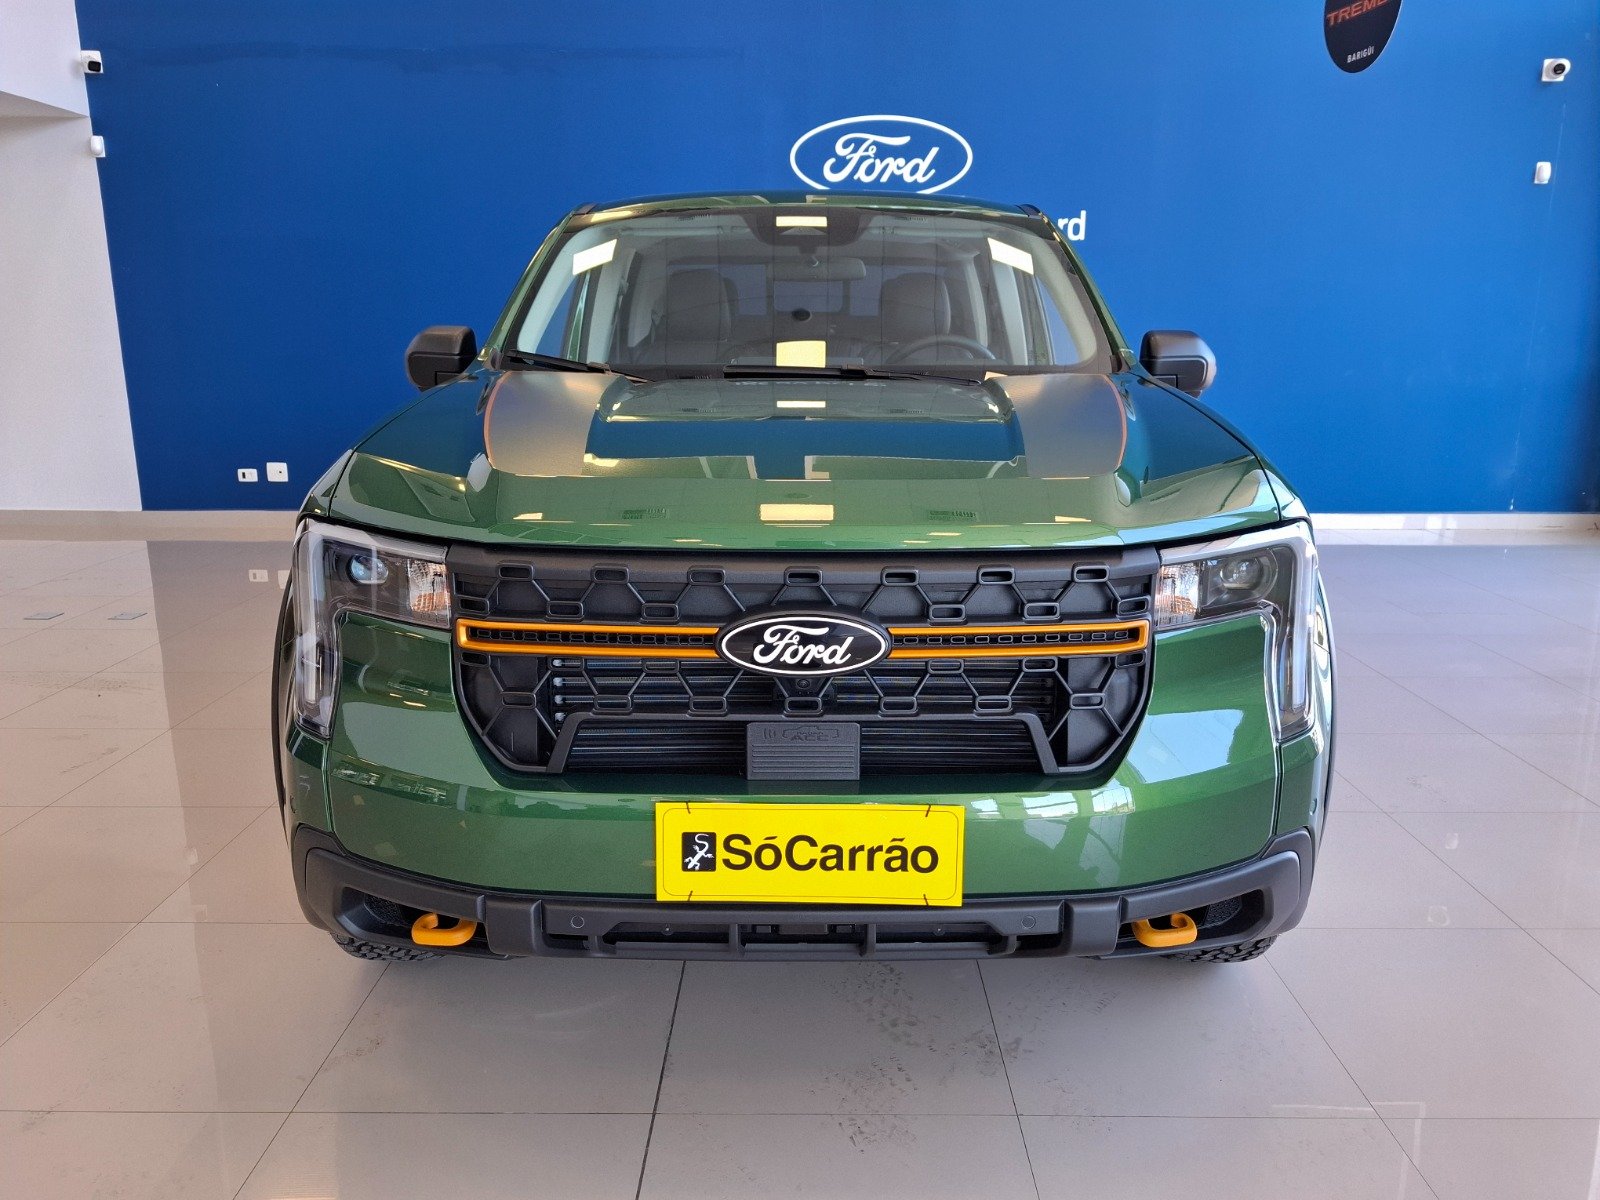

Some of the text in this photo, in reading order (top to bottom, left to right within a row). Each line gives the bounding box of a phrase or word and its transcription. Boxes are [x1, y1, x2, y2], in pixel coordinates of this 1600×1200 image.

[823, 133, 939, 182] Ford
[1057, 209, 1087, 241] rd
[753, 624, 854, 665] Ford
[722, 833, 939, 874] SóCarrão
